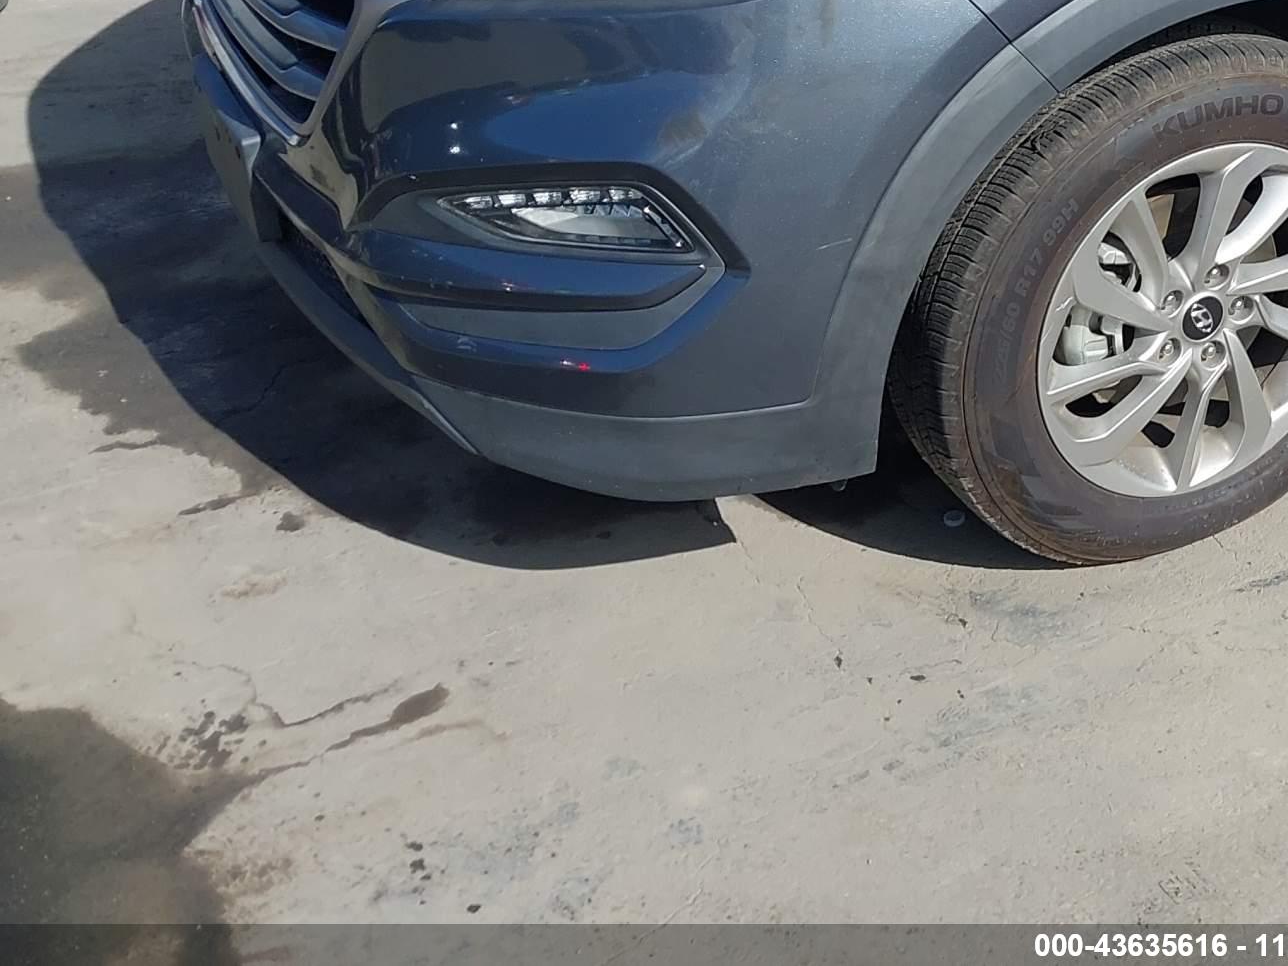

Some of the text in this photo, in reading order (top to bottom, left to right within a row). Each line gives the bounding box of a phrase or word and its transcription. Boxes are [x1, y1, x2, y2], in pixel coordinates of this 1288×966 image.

[1152, 94, 1283, 140] KUMHO
[1014, 247, 1042, 297] R17
[1043, 198, 1079, 246] 99H
